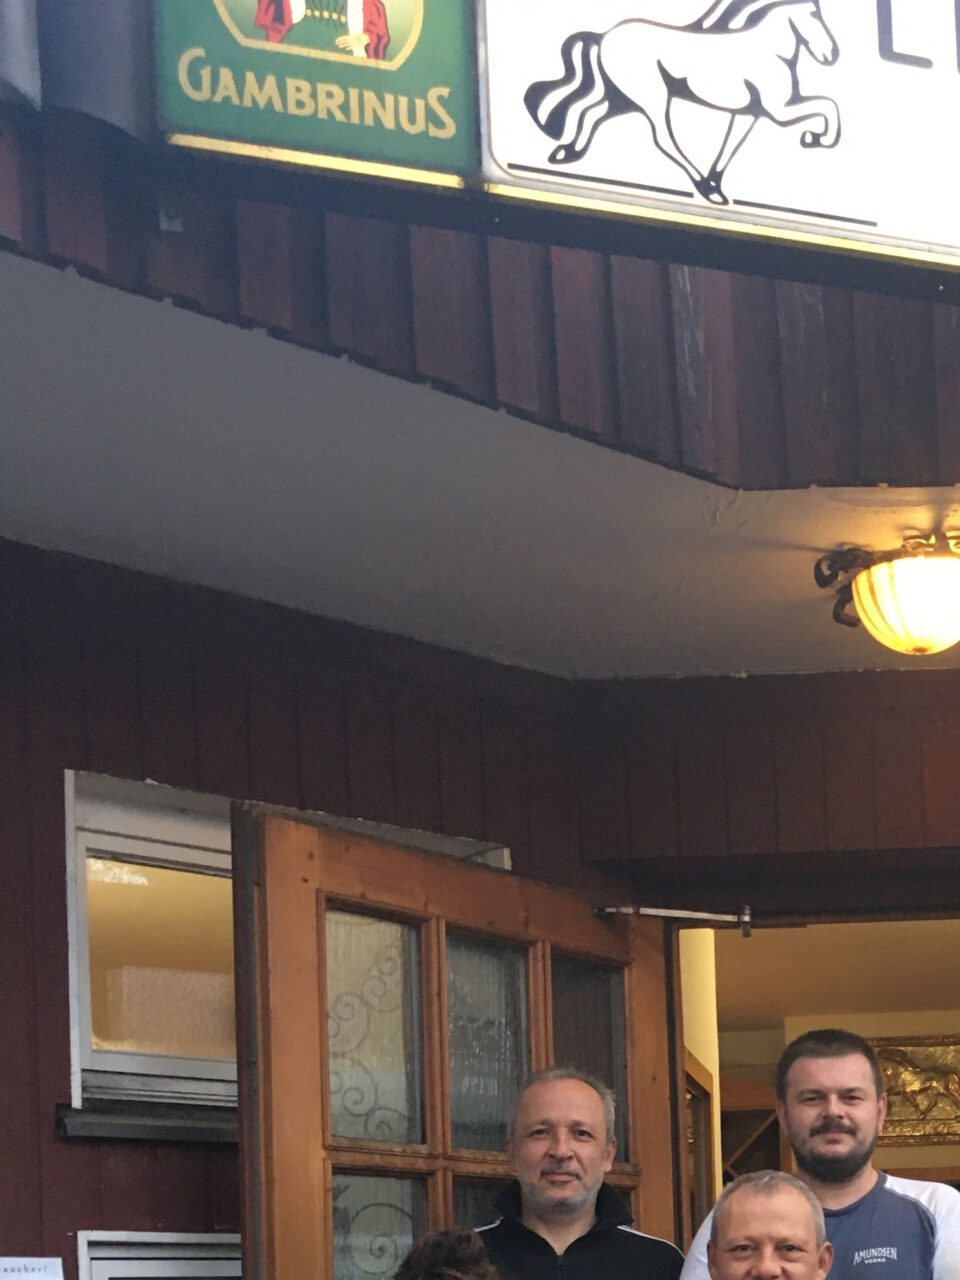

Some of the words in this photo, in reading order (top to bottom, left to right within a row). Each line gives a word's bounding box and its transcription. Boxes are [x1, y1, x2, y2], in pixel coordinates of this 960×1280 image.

[177, 46, 457, 139] GAMBRINUS
[853, 1247, 897, 1266] AMUNDSEN
[0, 1264, 47, 1273] aucher!
